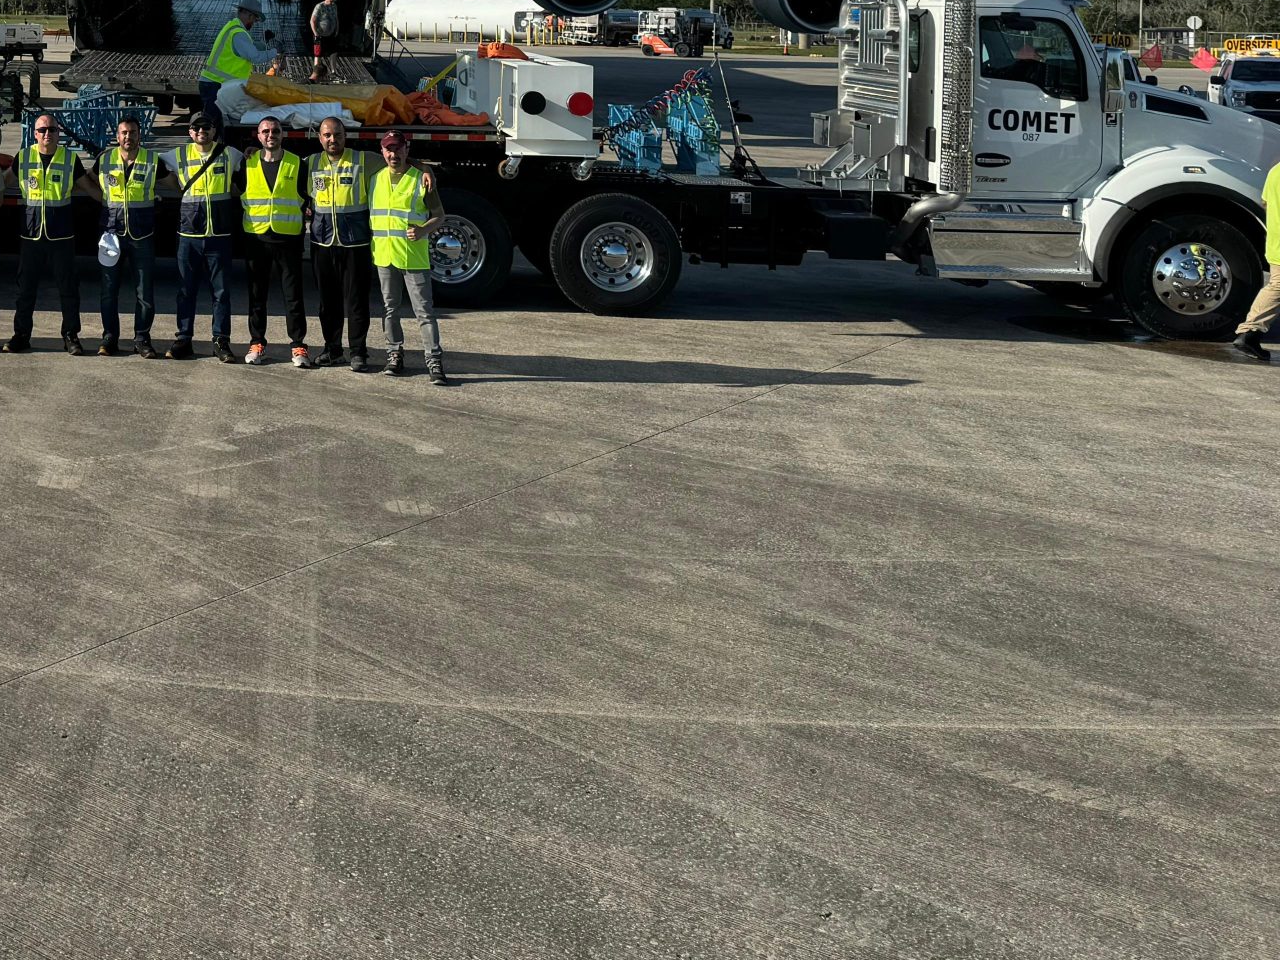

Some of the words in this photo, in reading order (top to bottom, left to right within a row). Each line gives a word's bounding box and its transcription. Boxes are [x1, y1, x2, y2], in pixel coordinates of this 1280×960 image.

[1105, 35, 1131, 47] LOAD
[1226, 40, 1272, 51] OVERSIZE
[988, 109, 1075, 134] COMET
[1022, 133, 1040, 142] 087
